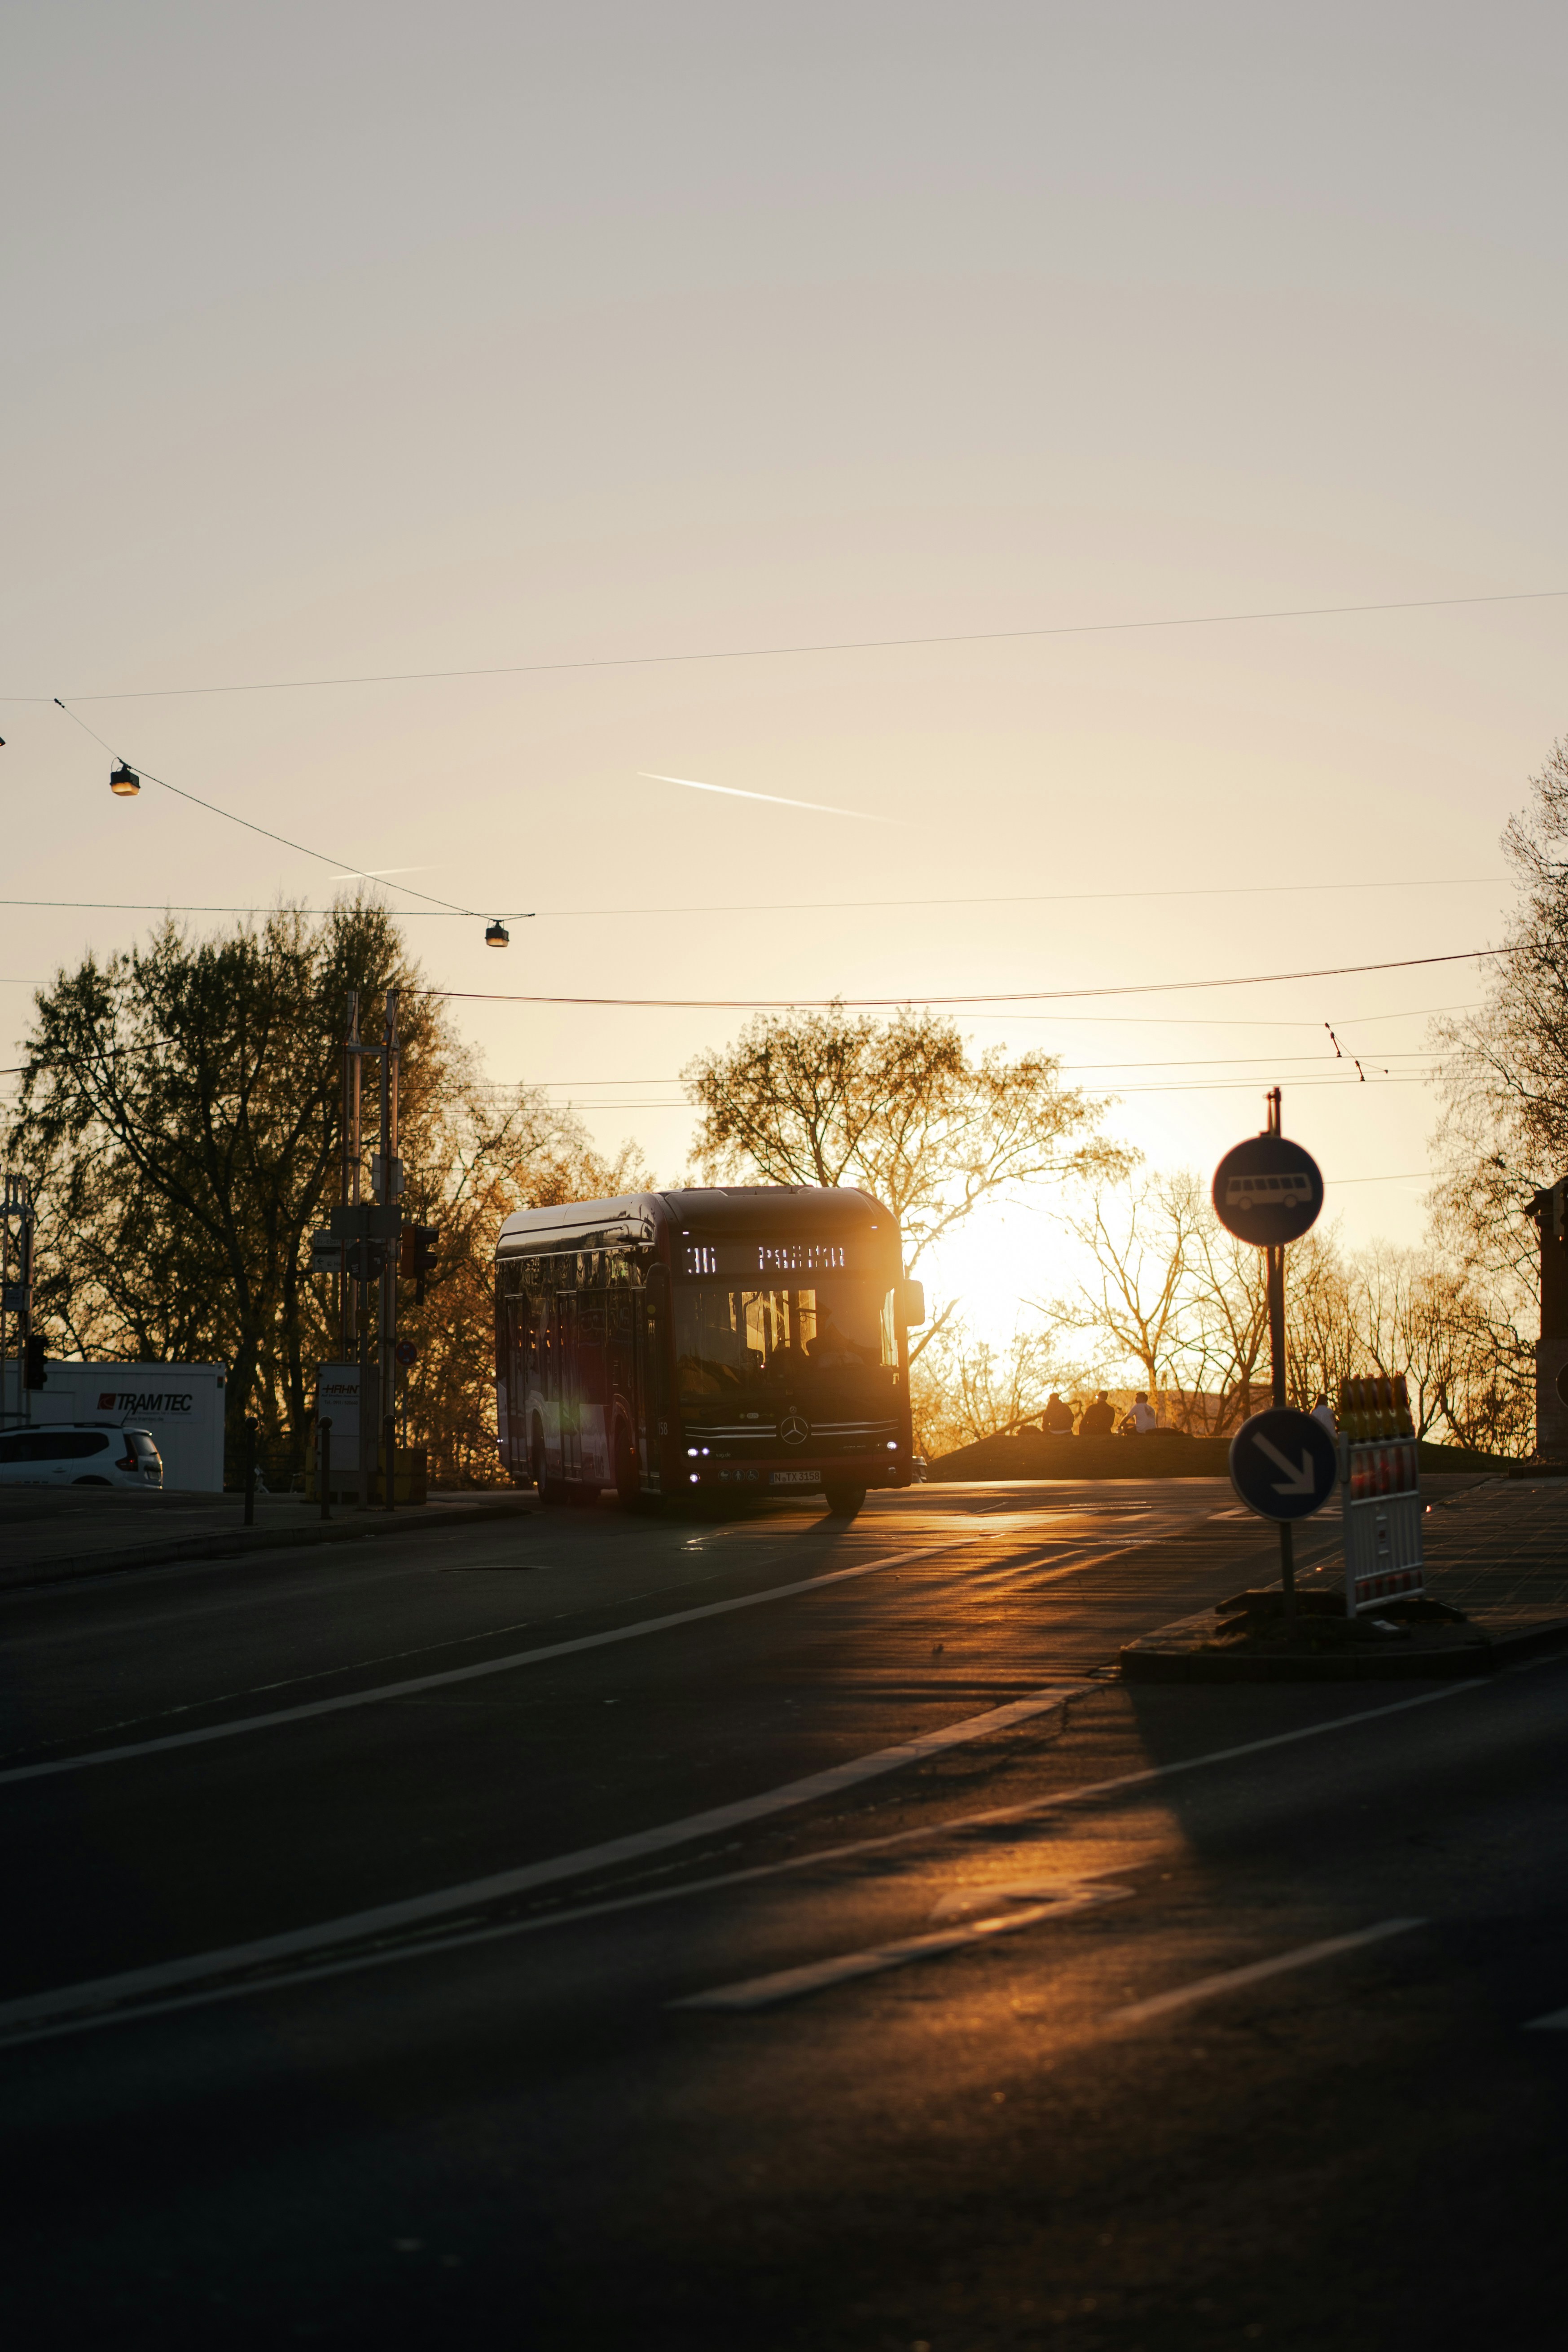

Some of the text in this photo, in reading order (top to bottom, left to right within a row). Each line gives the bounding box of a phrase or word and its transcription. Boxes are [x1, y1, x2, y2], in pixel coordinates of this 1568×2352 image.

[323, 1384, 359, 1393] HAHN
[775, 1472, 820, 1482] N TX 3158
